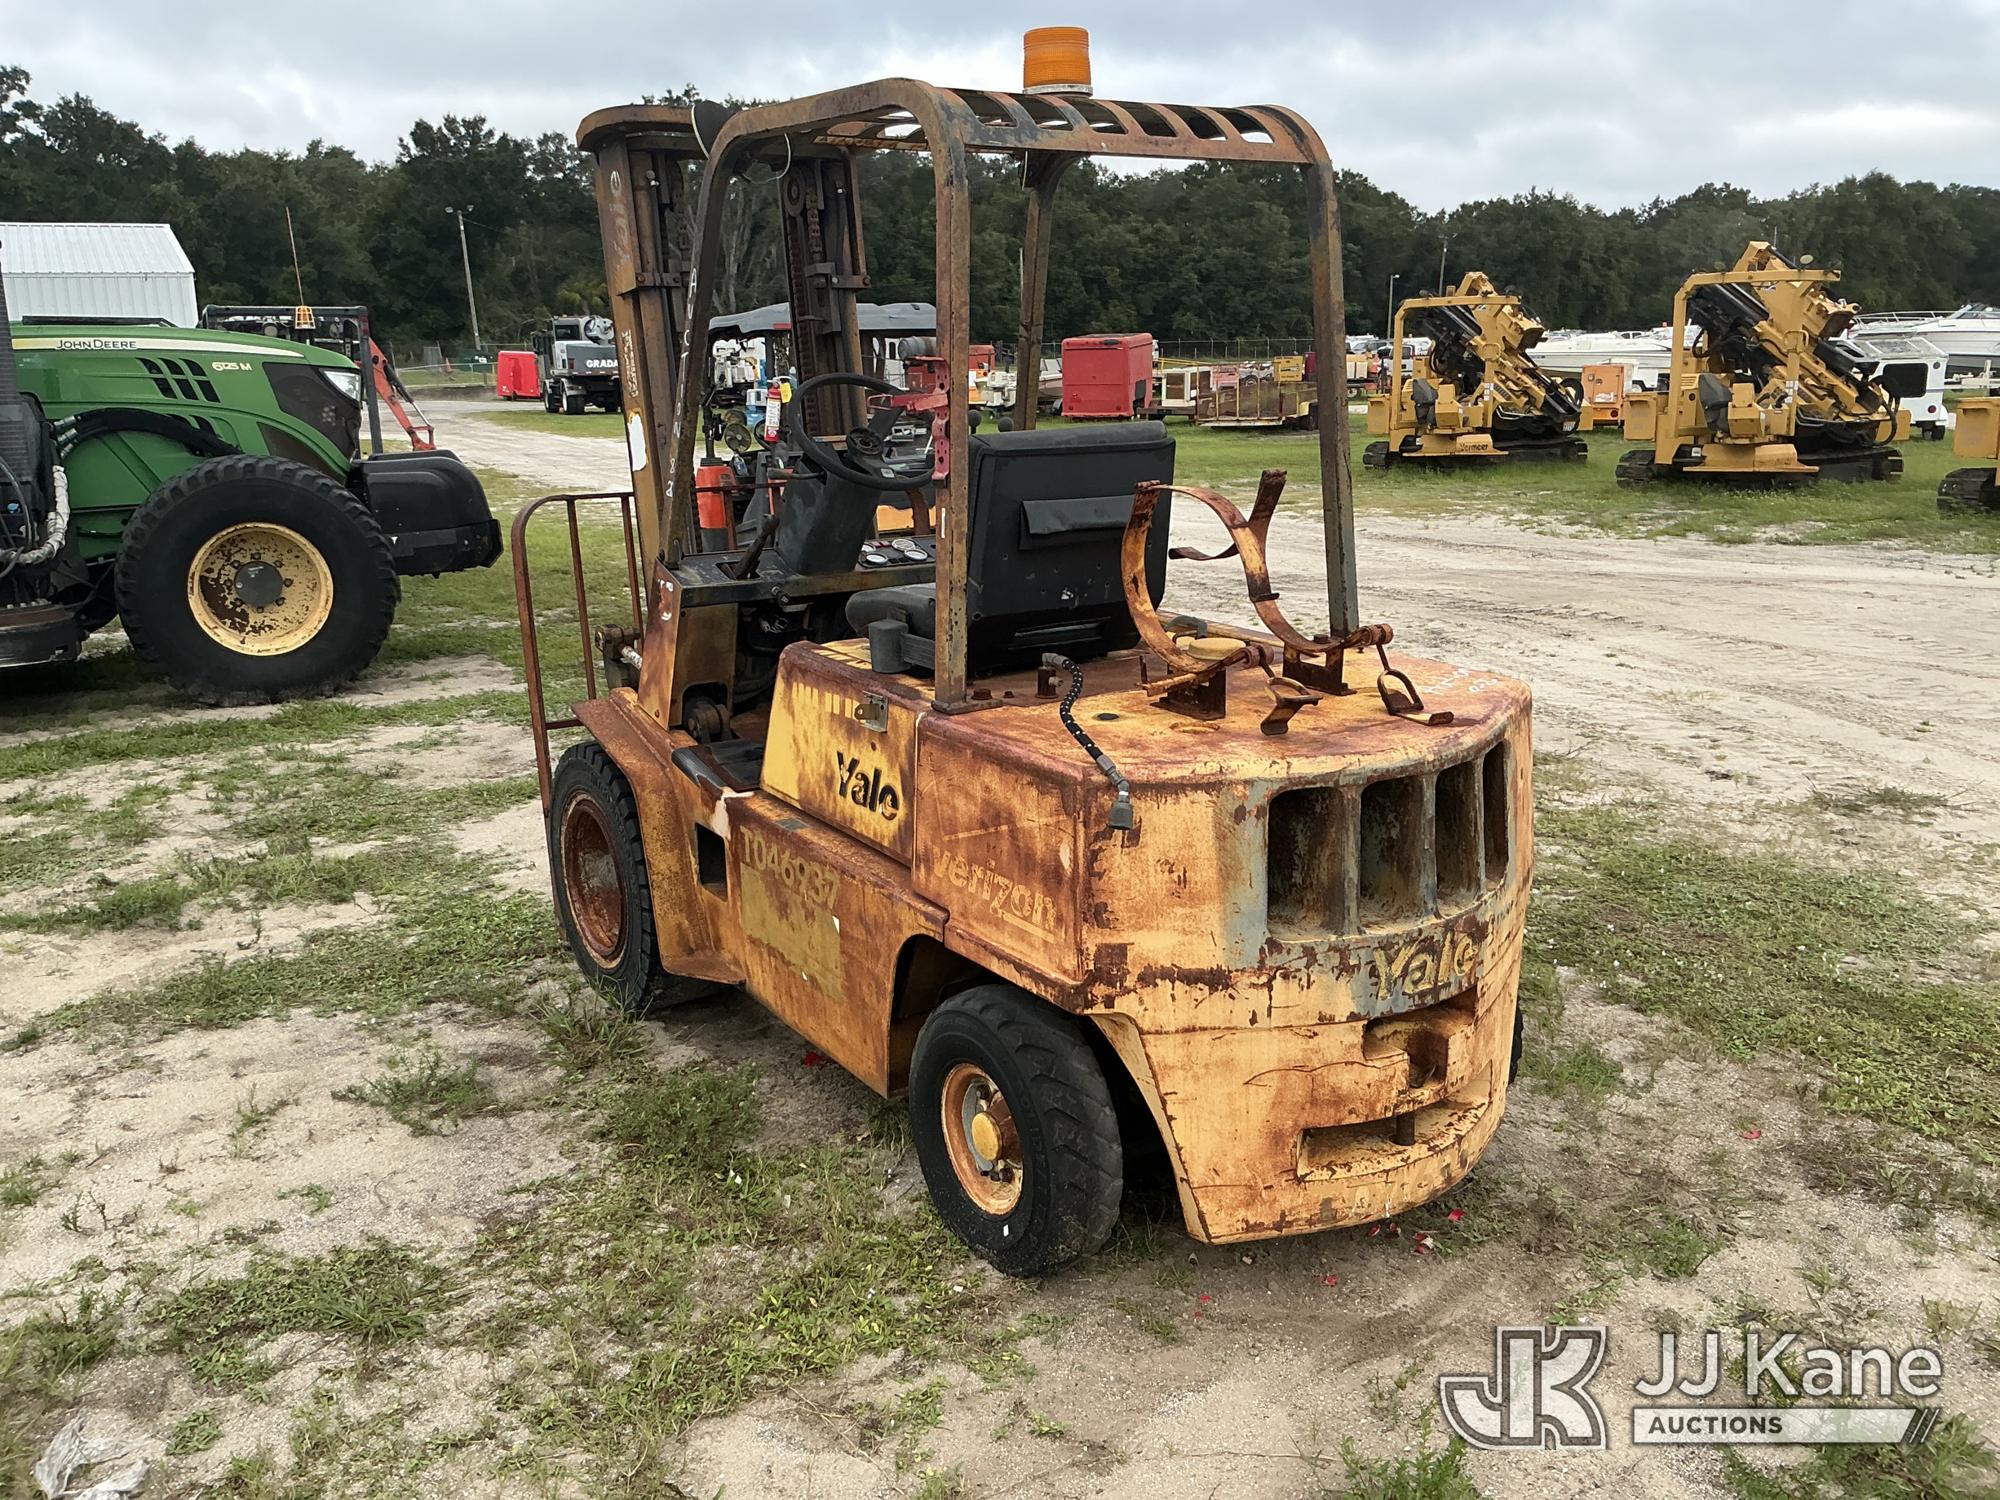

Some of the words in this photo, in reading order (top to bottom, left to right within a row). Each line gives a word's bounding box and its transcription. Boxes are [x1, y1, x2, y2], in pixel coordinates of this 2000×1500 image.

[56, 339, 92, 350] JOHN
[94, 340, 137, 350] DEERE
[836, 751, 901, 821] Yale
[932, 845, 1058, 932] verizon
[1373, 930, 1478, 1000] Yale
